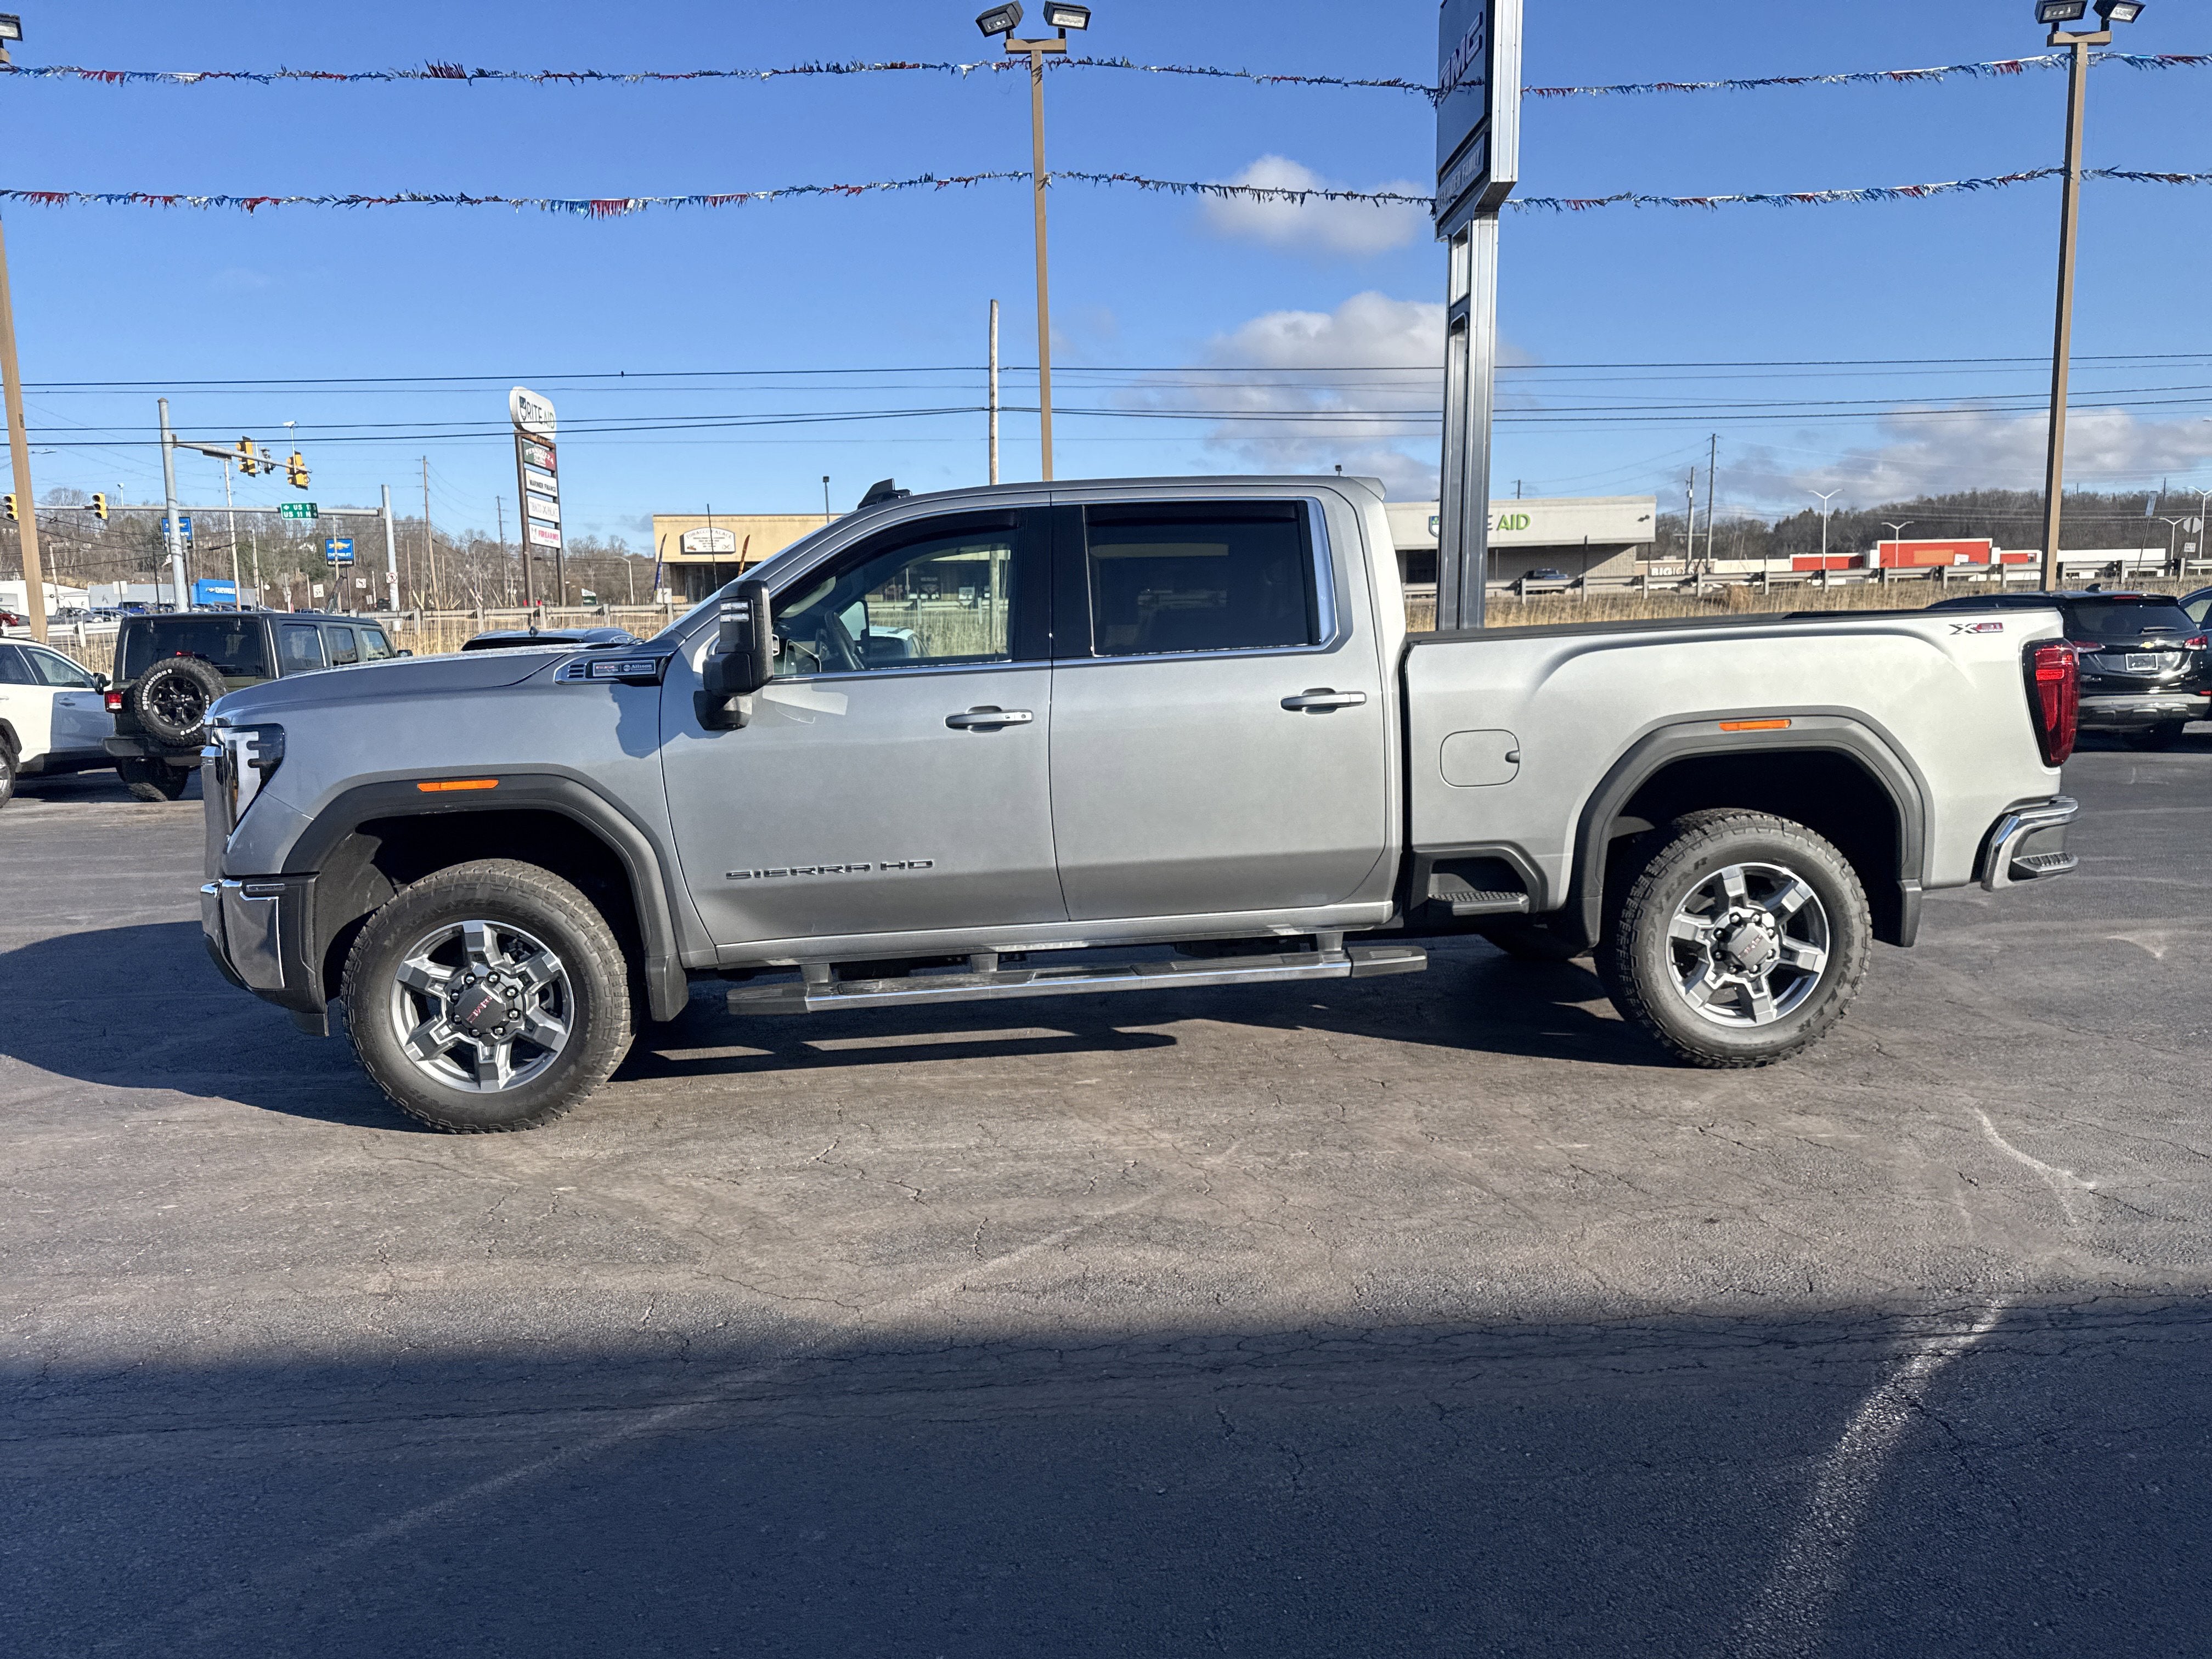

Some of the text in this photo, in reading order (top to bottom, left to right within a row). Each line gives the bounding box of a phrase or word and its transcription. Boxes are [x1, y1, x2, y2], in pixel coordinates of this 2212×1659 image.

[1440, 11, 1483, 104] GMC
[527, 402, 555, 430] RITE AID
[1497, 514, 1531, 531] AID
[1651, 567, 1673, 576] BIG
[215, 586, 236, 595] CHEVROLE
[726, 859, 933, 879] SIERRA HD
[466, 995, 493, 1024] GMC
